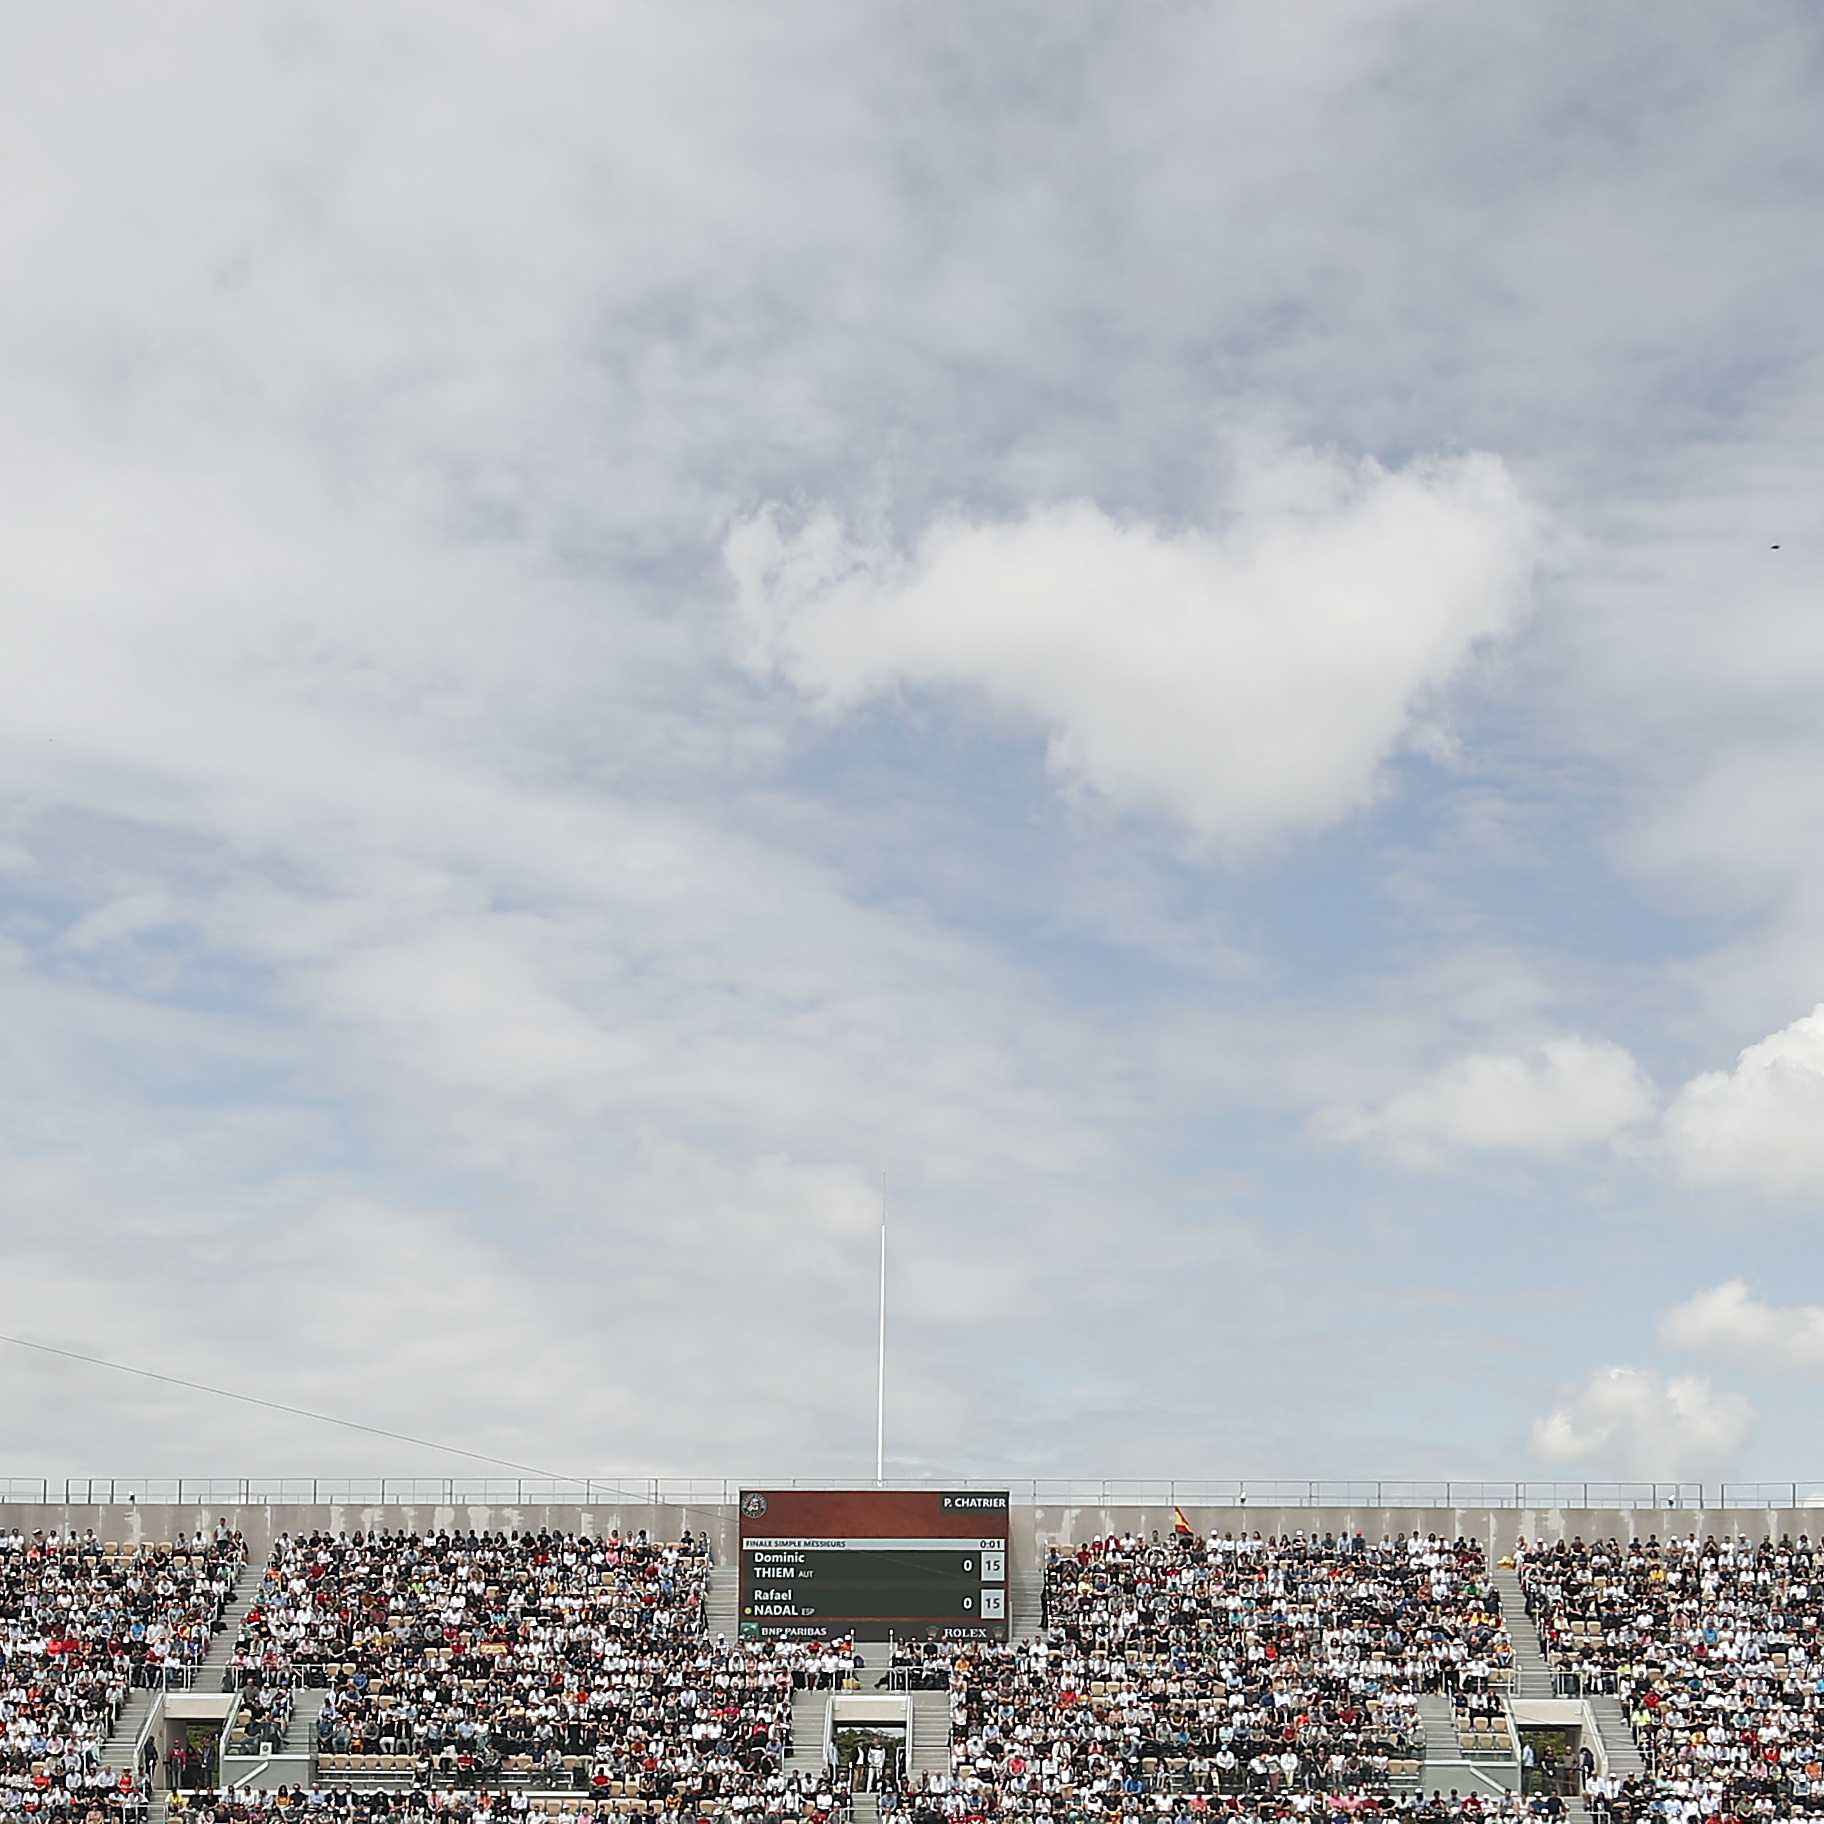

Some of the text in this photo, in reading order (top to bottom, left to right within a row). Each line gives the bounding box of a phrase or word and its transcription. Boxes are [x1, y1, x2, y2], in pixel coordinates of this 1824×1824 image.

[943, 1498, 1006, 1508] P. CHATRIER
[745, 1540, 846, 1548] FINALE SIMPLE MESSIEURS
[980, 1540, 1001, 1549] 0:01
[754, 1552, 805, 1563] Dominic
[963, 1559, 973, 1571] 0
[985, 1560, 1000, 1571] 15
[754, 1567, 814, 1578] THIEM AUT
[754, 1590, 792, 1600] Rafael
[963, 1597, 973, 1609] 0
[985, 1597, 1000, 1609] 15
[754, 1605, 815, 1616] NADAL ESP
[761, 1627, 827, 1636] BNP PARIBAS
[944, 1628, 987, 1638] ROLEX
